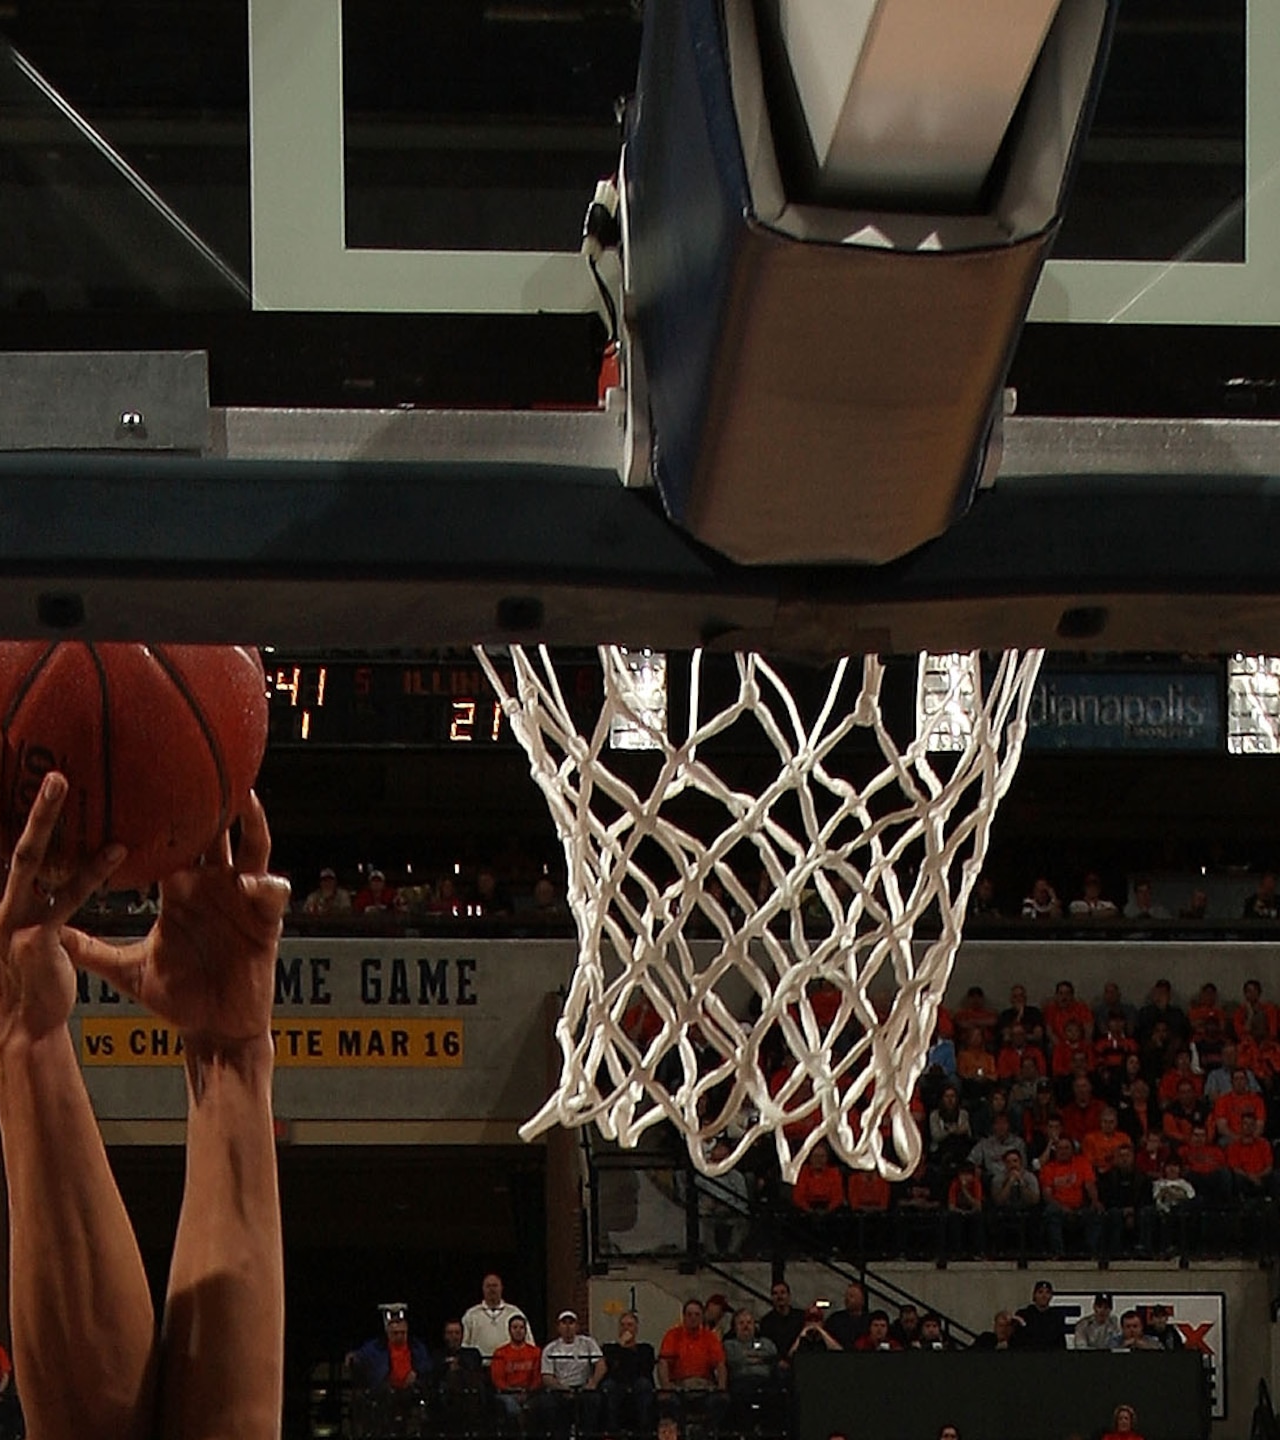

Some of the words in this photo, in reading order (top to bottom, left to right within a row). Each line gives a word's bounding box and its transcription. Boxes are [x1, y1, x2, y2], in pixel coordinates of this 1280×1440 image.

[275, 959, 331, 1005] ME
[361, 958, 478, 1005] GAME
[338, 1030, 409, 1057] MAR
[425, 1030, 461, 1057] 16
